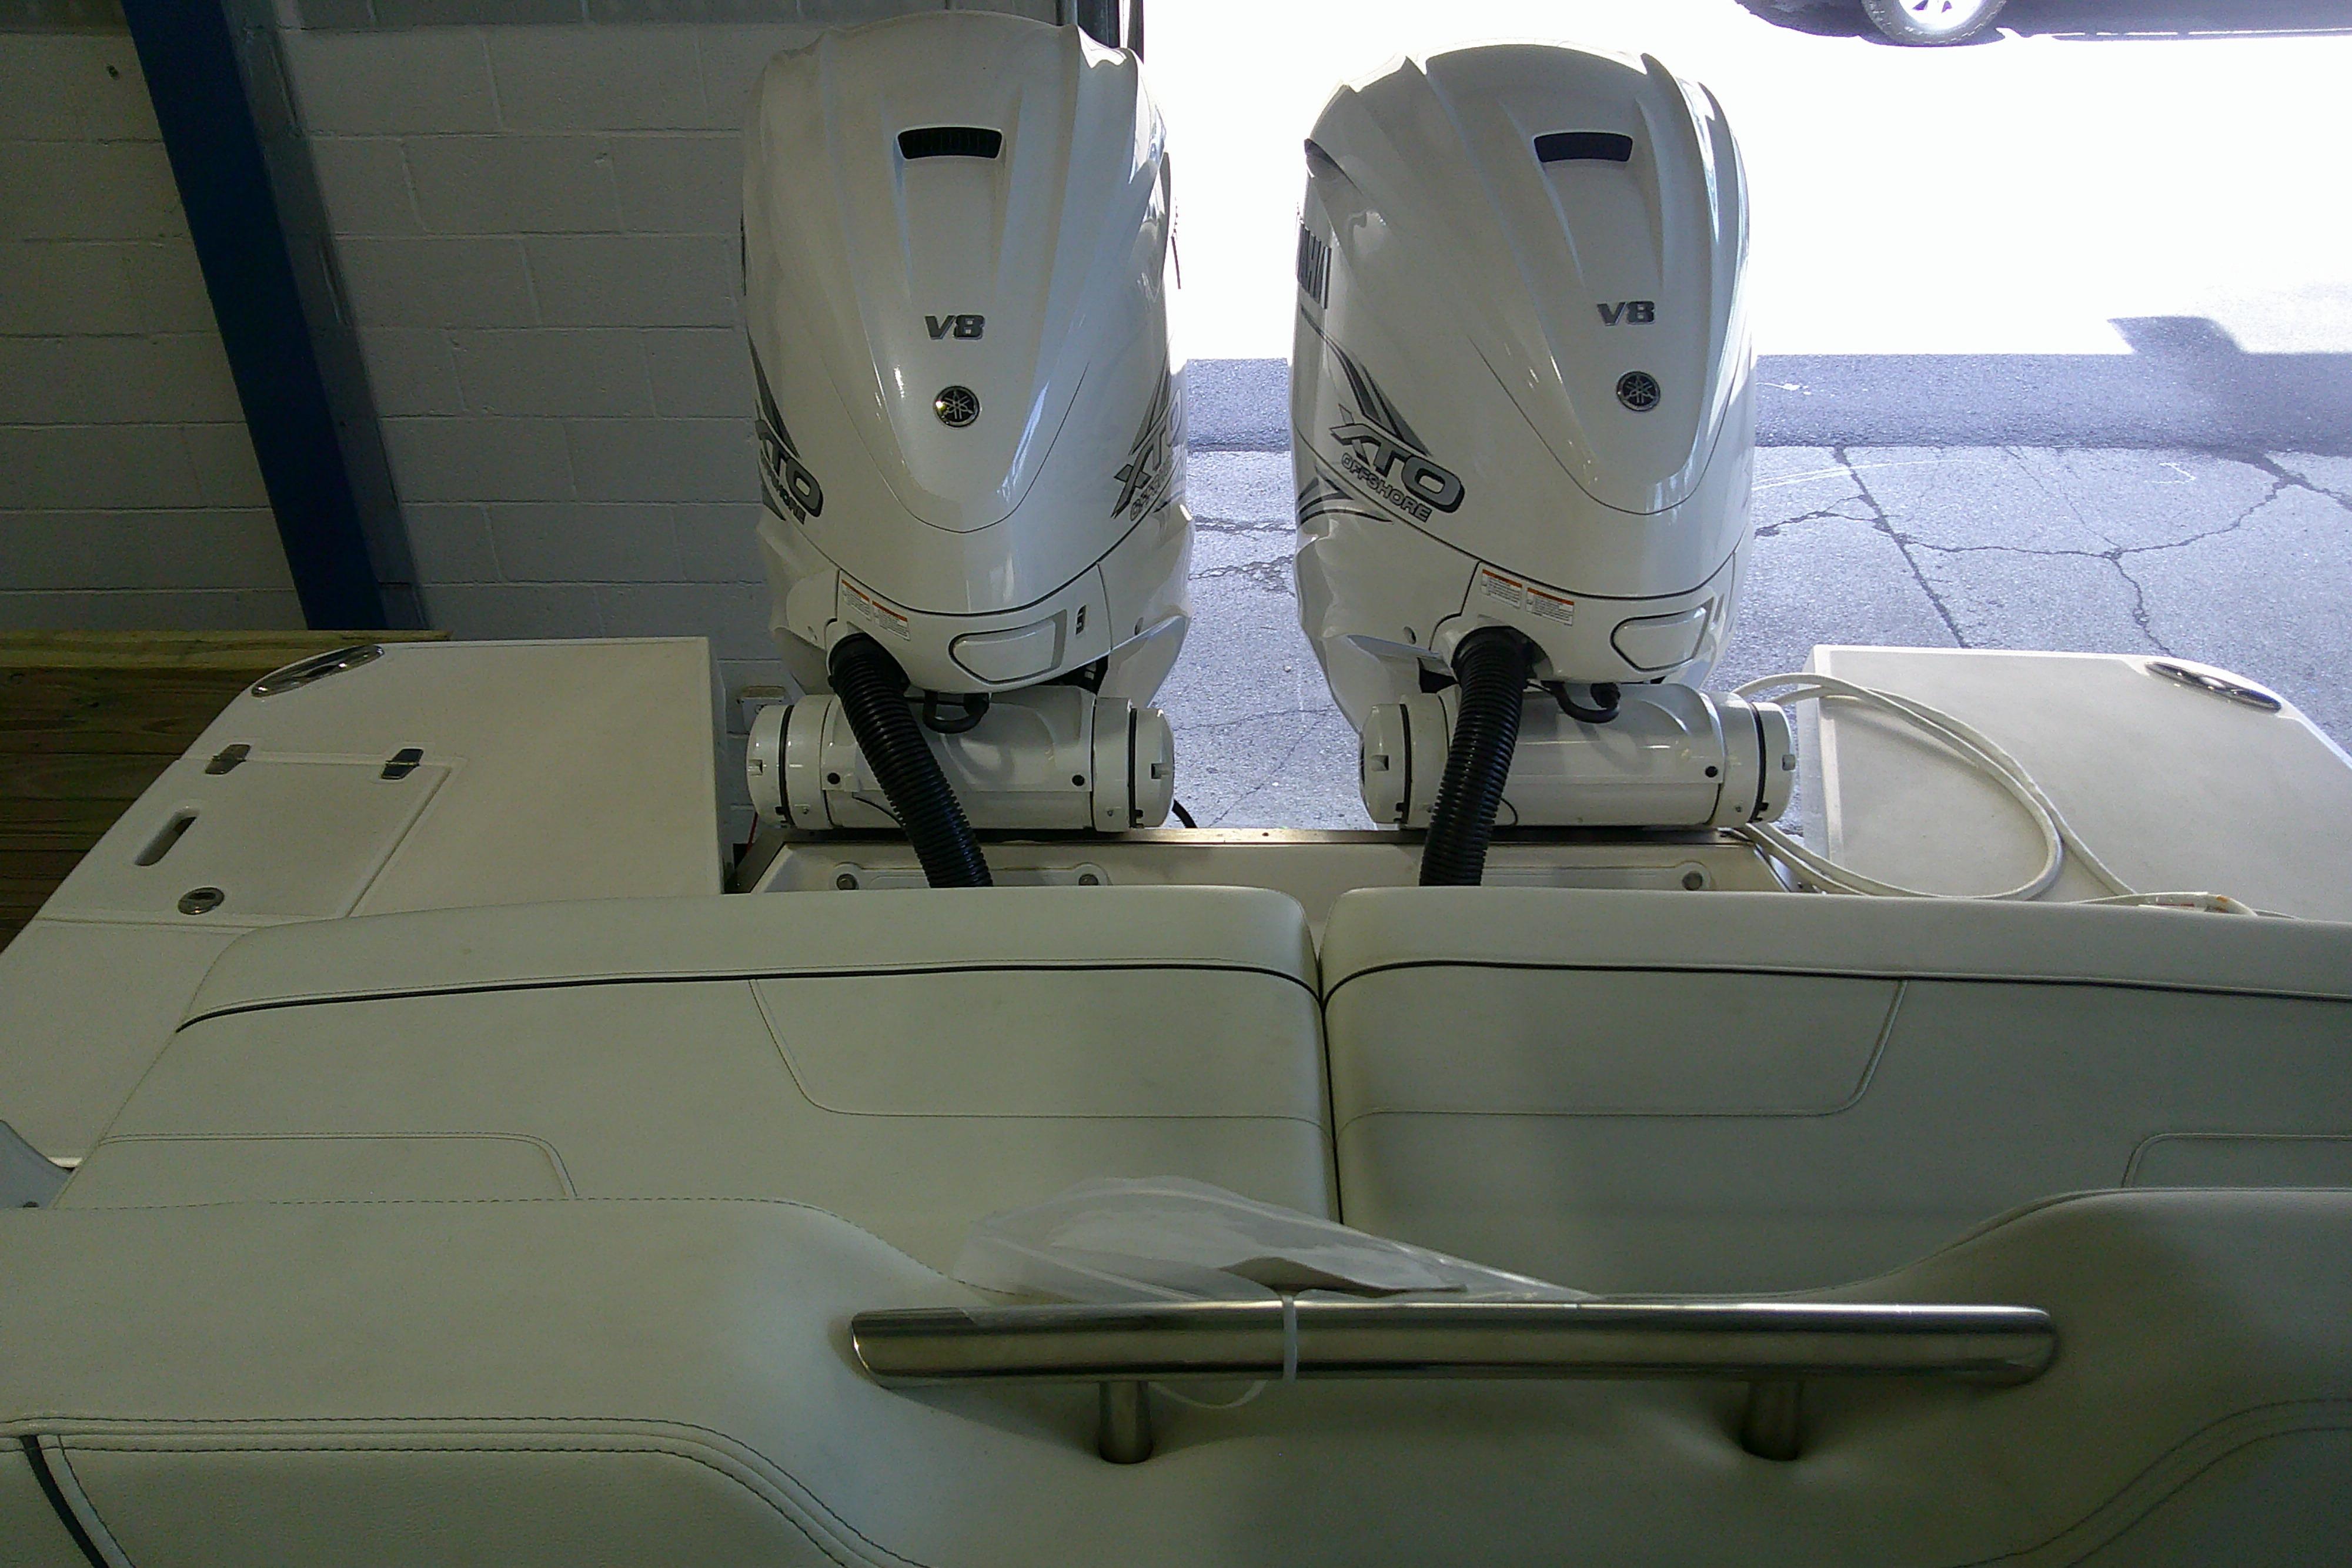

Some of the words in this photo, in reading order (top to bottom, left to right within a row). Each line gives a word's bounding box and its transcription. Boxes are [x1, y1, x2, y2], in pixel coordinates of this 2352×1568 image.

[924, 314, 985, 340] V8
[1597, 300, 1655, 326] V8
[1329, 403, 1465, 513] XTO
[1341, 452, 1432, 523] OFFSHORE
